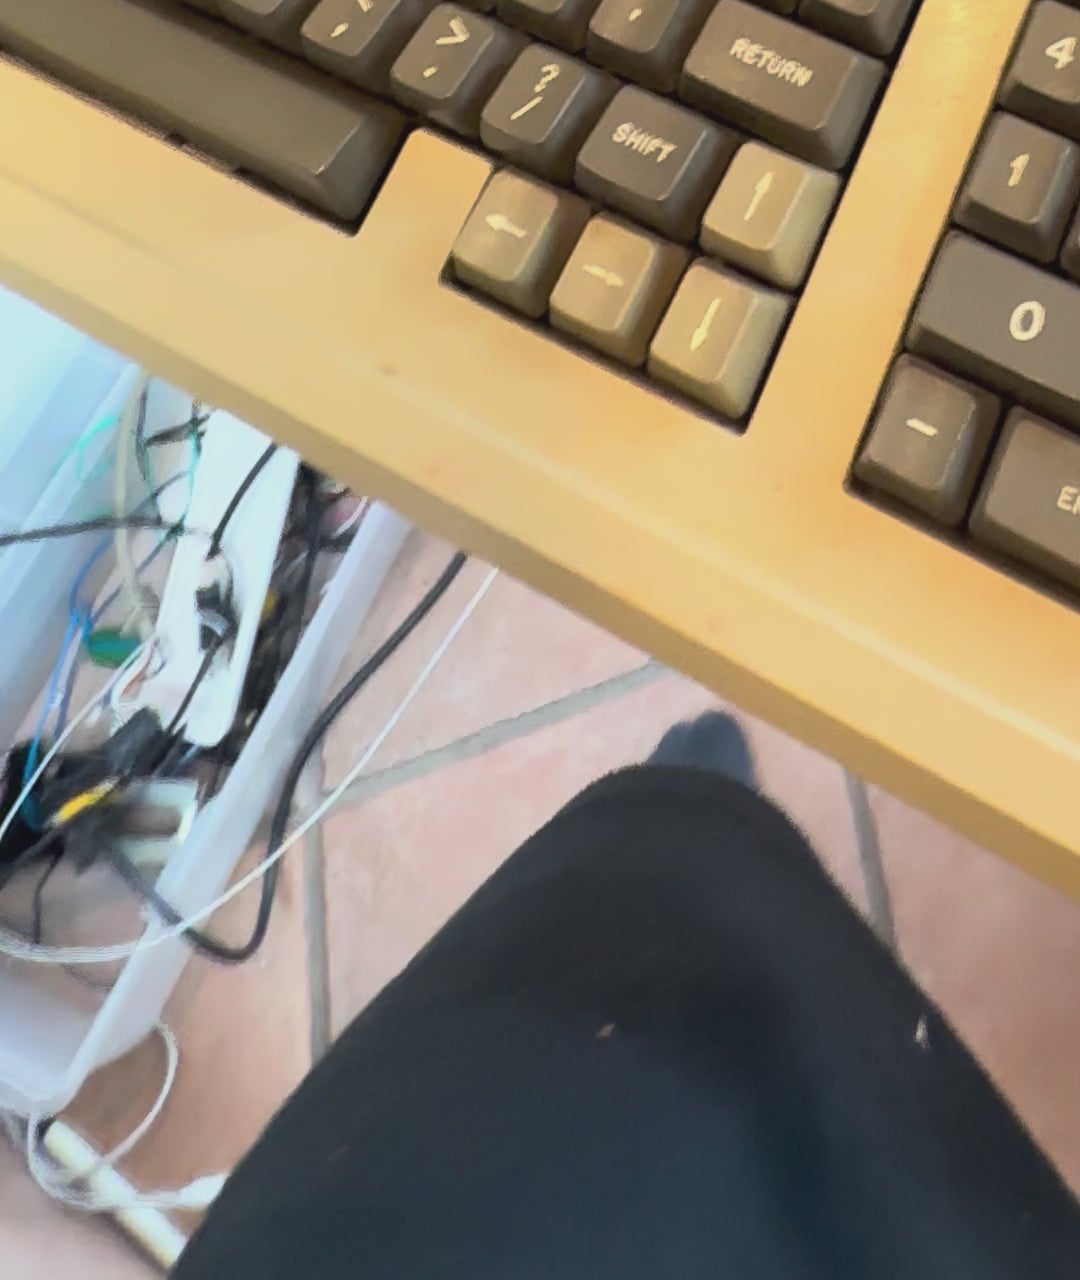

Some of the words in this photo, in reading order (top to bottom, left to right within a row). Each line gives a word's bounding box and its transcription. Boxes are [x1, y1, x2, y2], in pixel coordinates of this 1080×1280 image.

[729, 36, 814, 89] RETURN
[1044, 35, 1080, 71] 4
[611, 120, 678, 164] SHIFT
[1007, 153, 1031, 188] 1
[1008, 299, 1046, 342] 0
